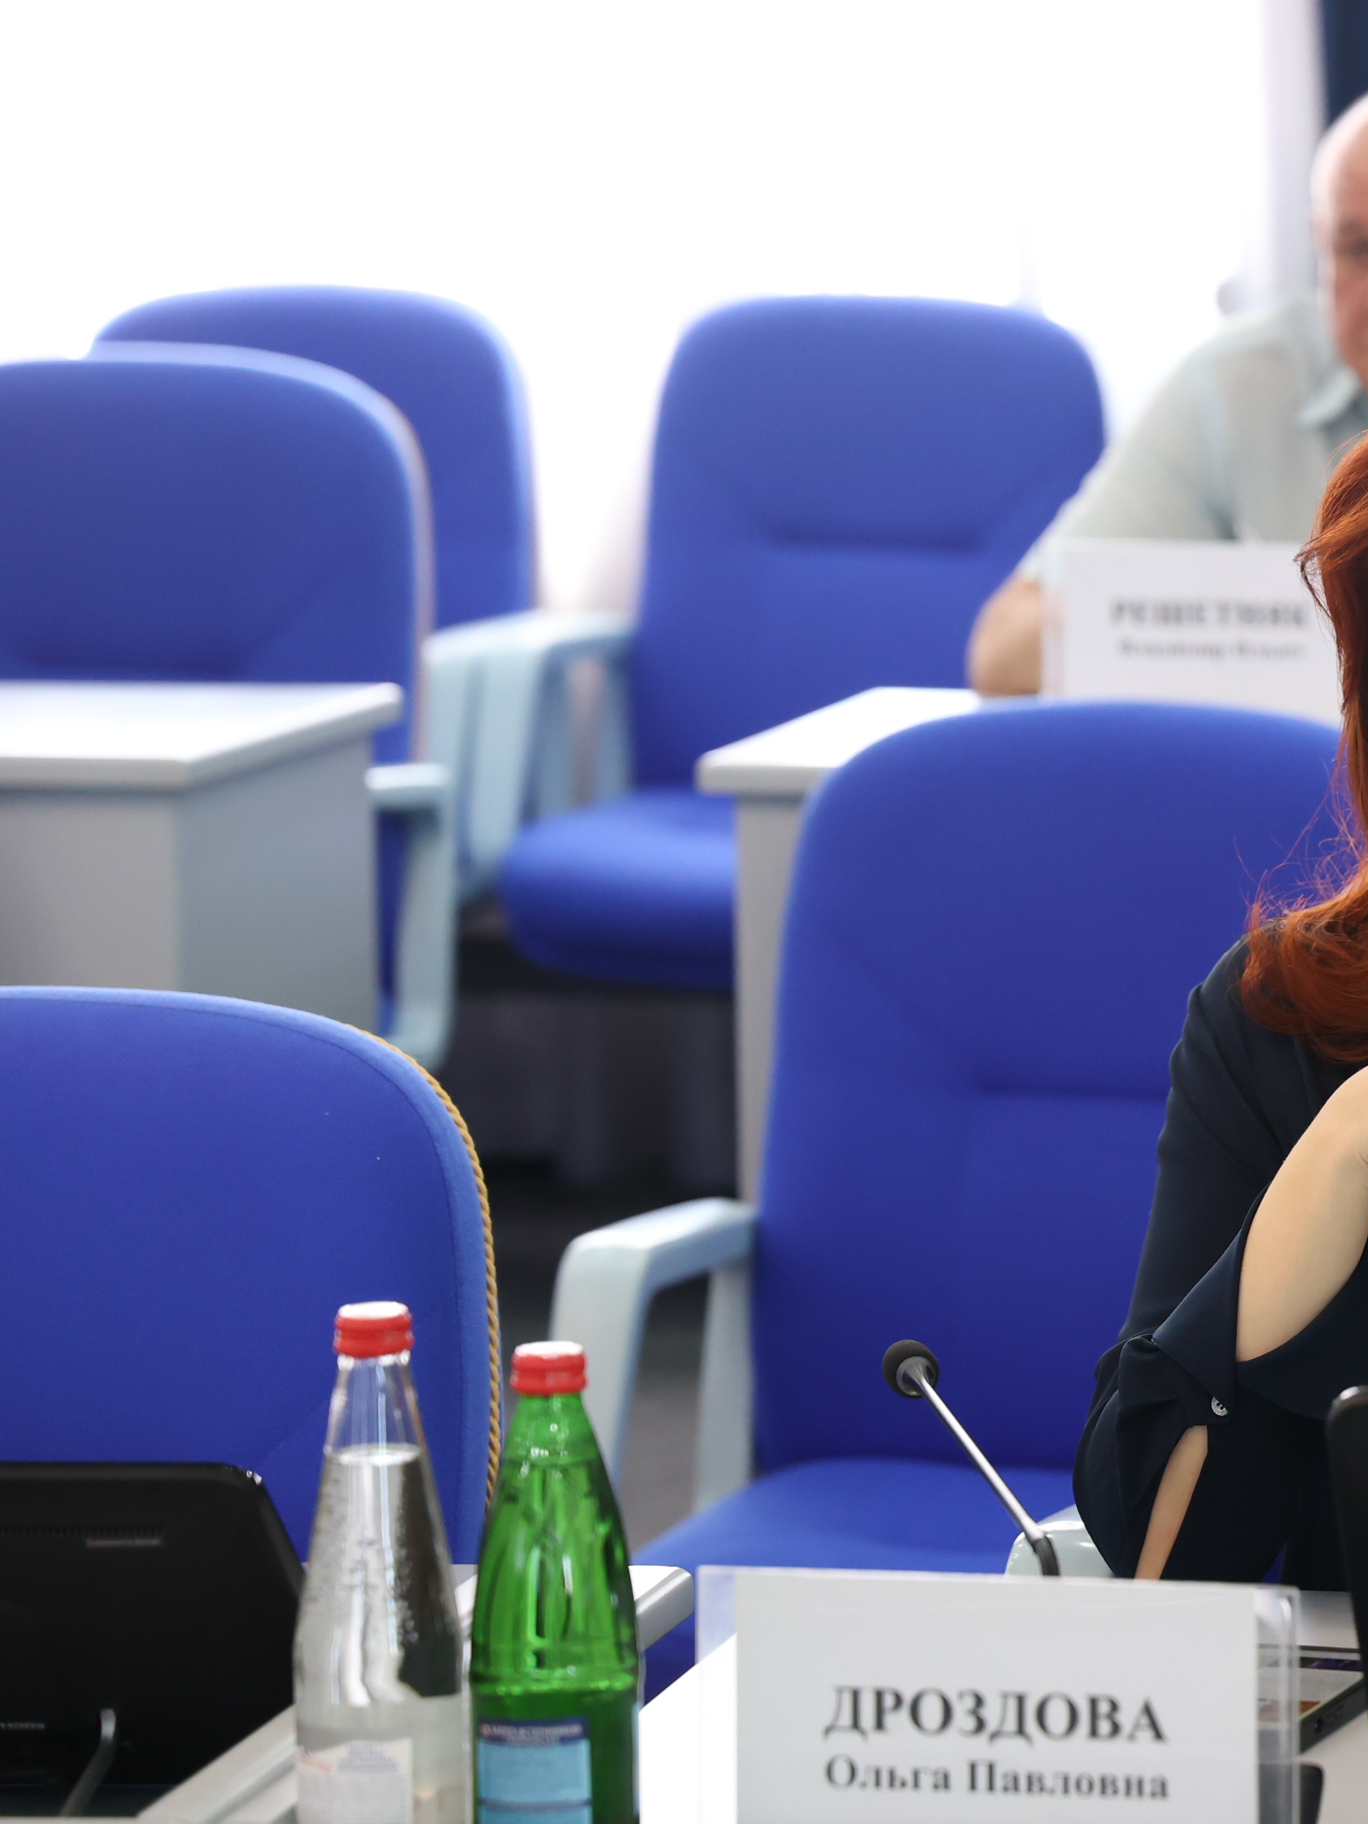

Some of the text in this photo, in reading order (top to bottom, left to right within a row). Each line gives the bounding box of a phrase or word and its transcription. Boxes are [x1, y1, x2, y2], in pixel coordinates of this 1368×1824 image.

[823, 1686, 1167, 1746] ДРОЗДОВА
[824, 1755, 1168, 1799] Ольга Павловна
